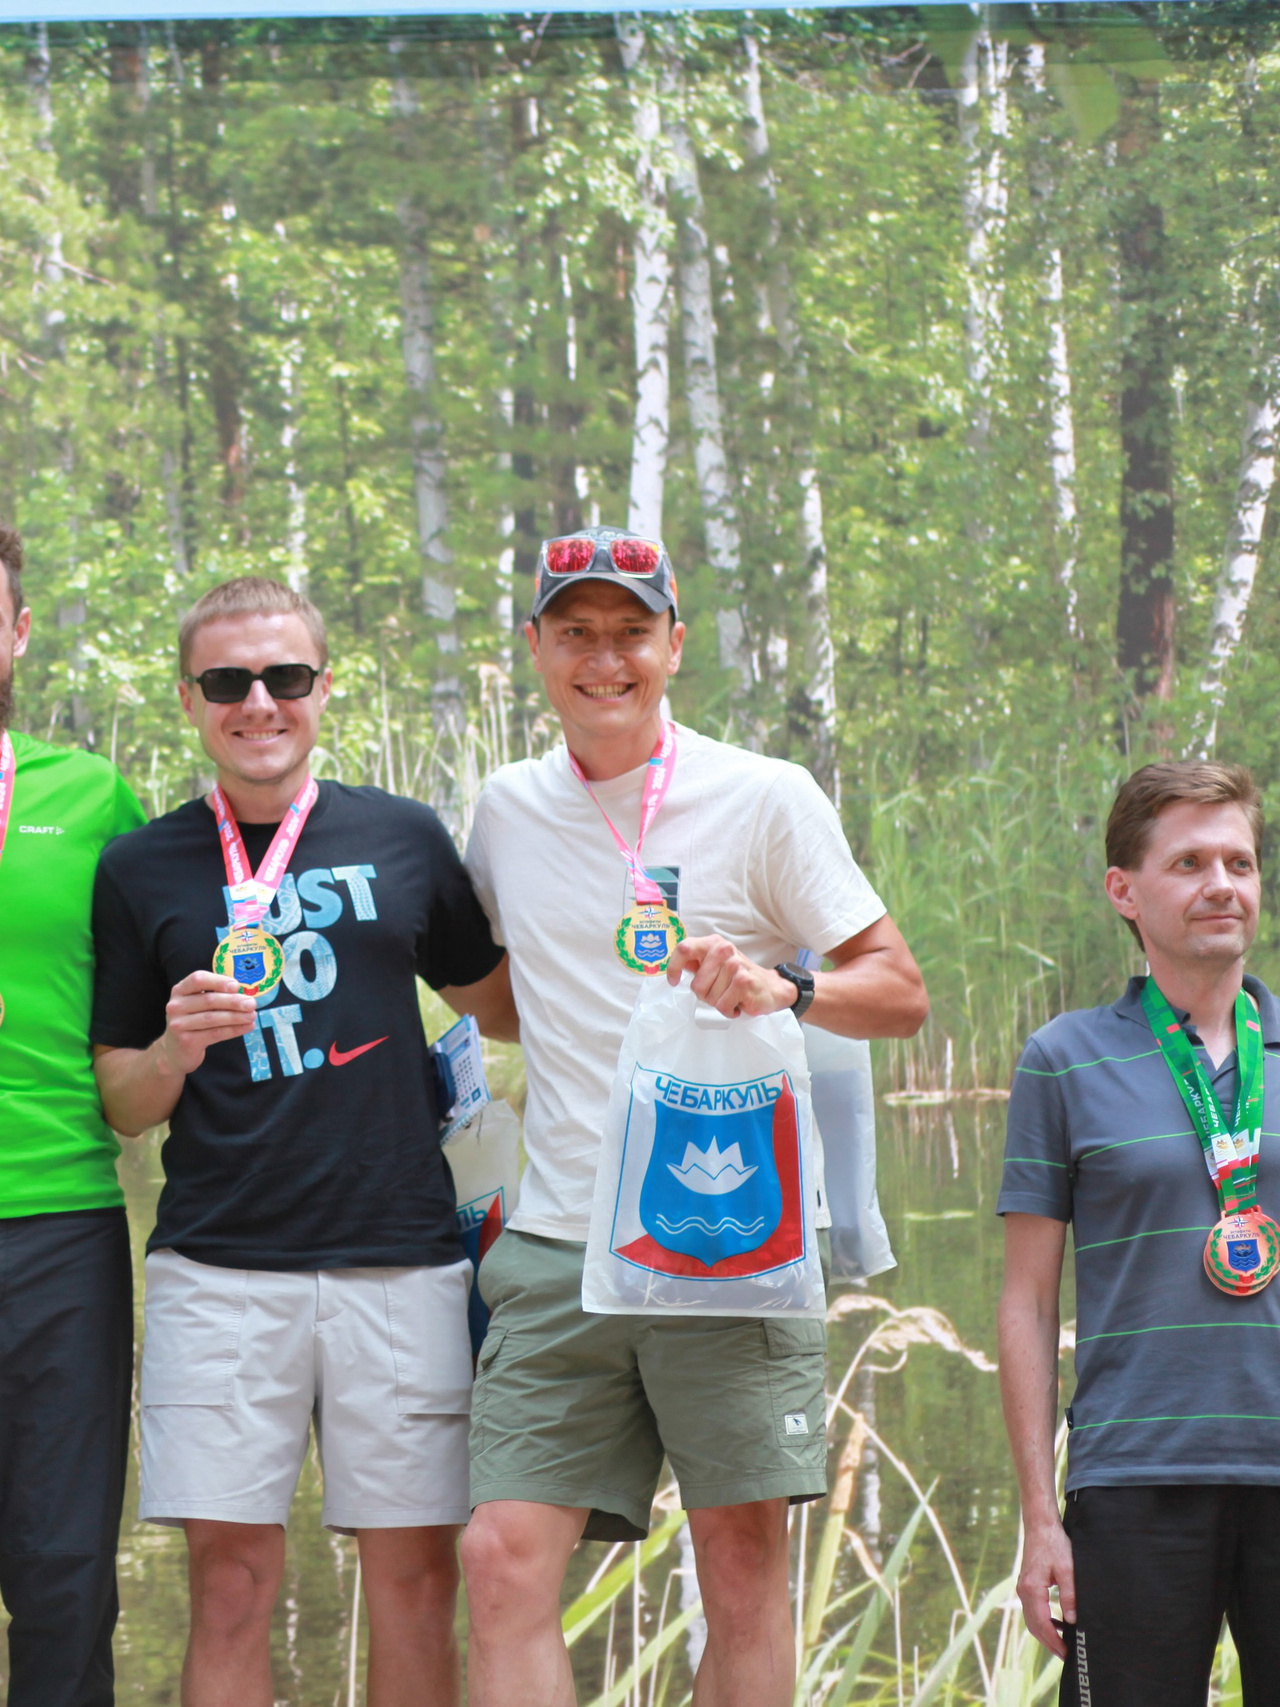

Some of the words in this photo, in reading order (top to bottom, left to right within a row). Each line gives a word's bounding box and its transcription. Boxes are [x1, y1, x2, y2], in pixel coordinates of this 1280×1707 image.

[19, 825, 54, 834] CRAFT
[655, 1075, 782, 1111] ЧЕБАРКУЛЬ
[1223, 1232, 1260, 1240] ЧЕБАРКУЛЬ
